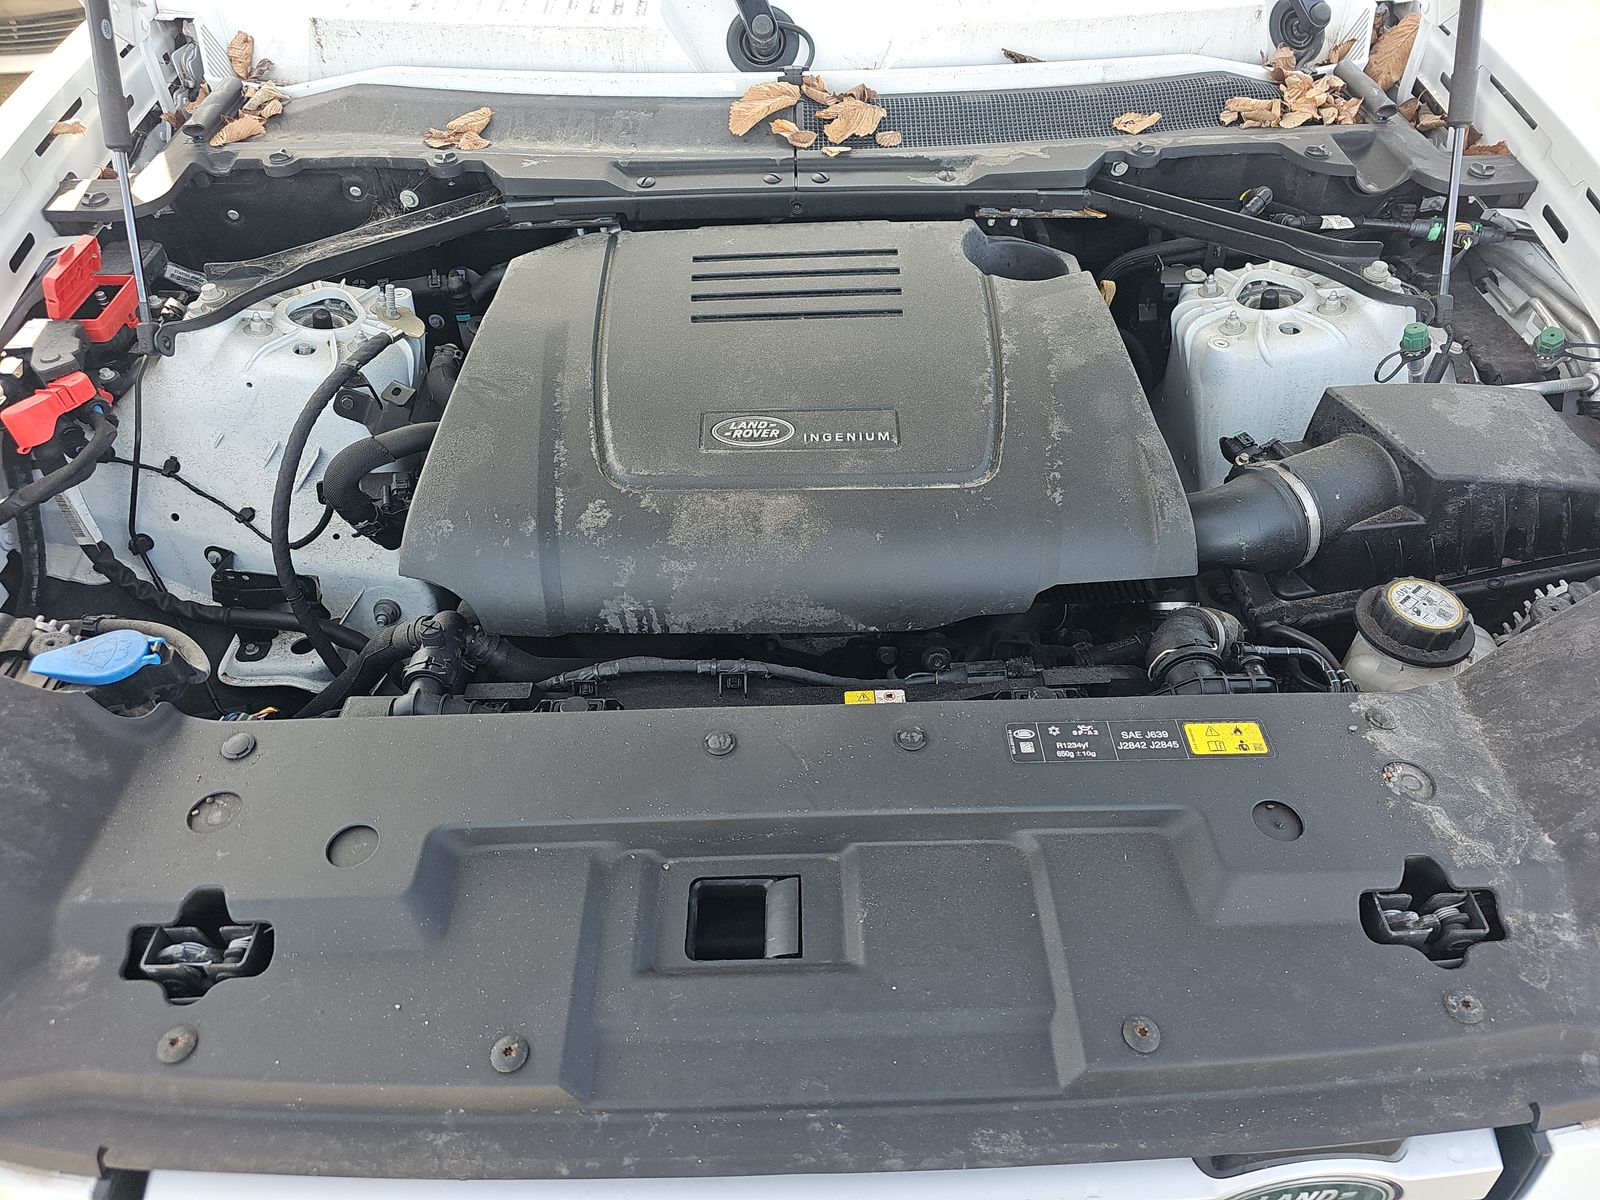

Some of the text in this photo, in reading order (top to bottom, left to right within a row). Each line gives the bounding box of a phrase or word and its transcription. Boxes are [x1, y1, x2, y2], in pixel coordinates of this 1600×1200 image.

[803, 432, 890, 442] INGENIUM
[1121, 730, 1169, 739] SAE J639
[1056, 741, 1089, 750] R1234yf
[1117, 740, 1179, 750] J2842 J2845
[1056, 750, 1075, 759] 650g
